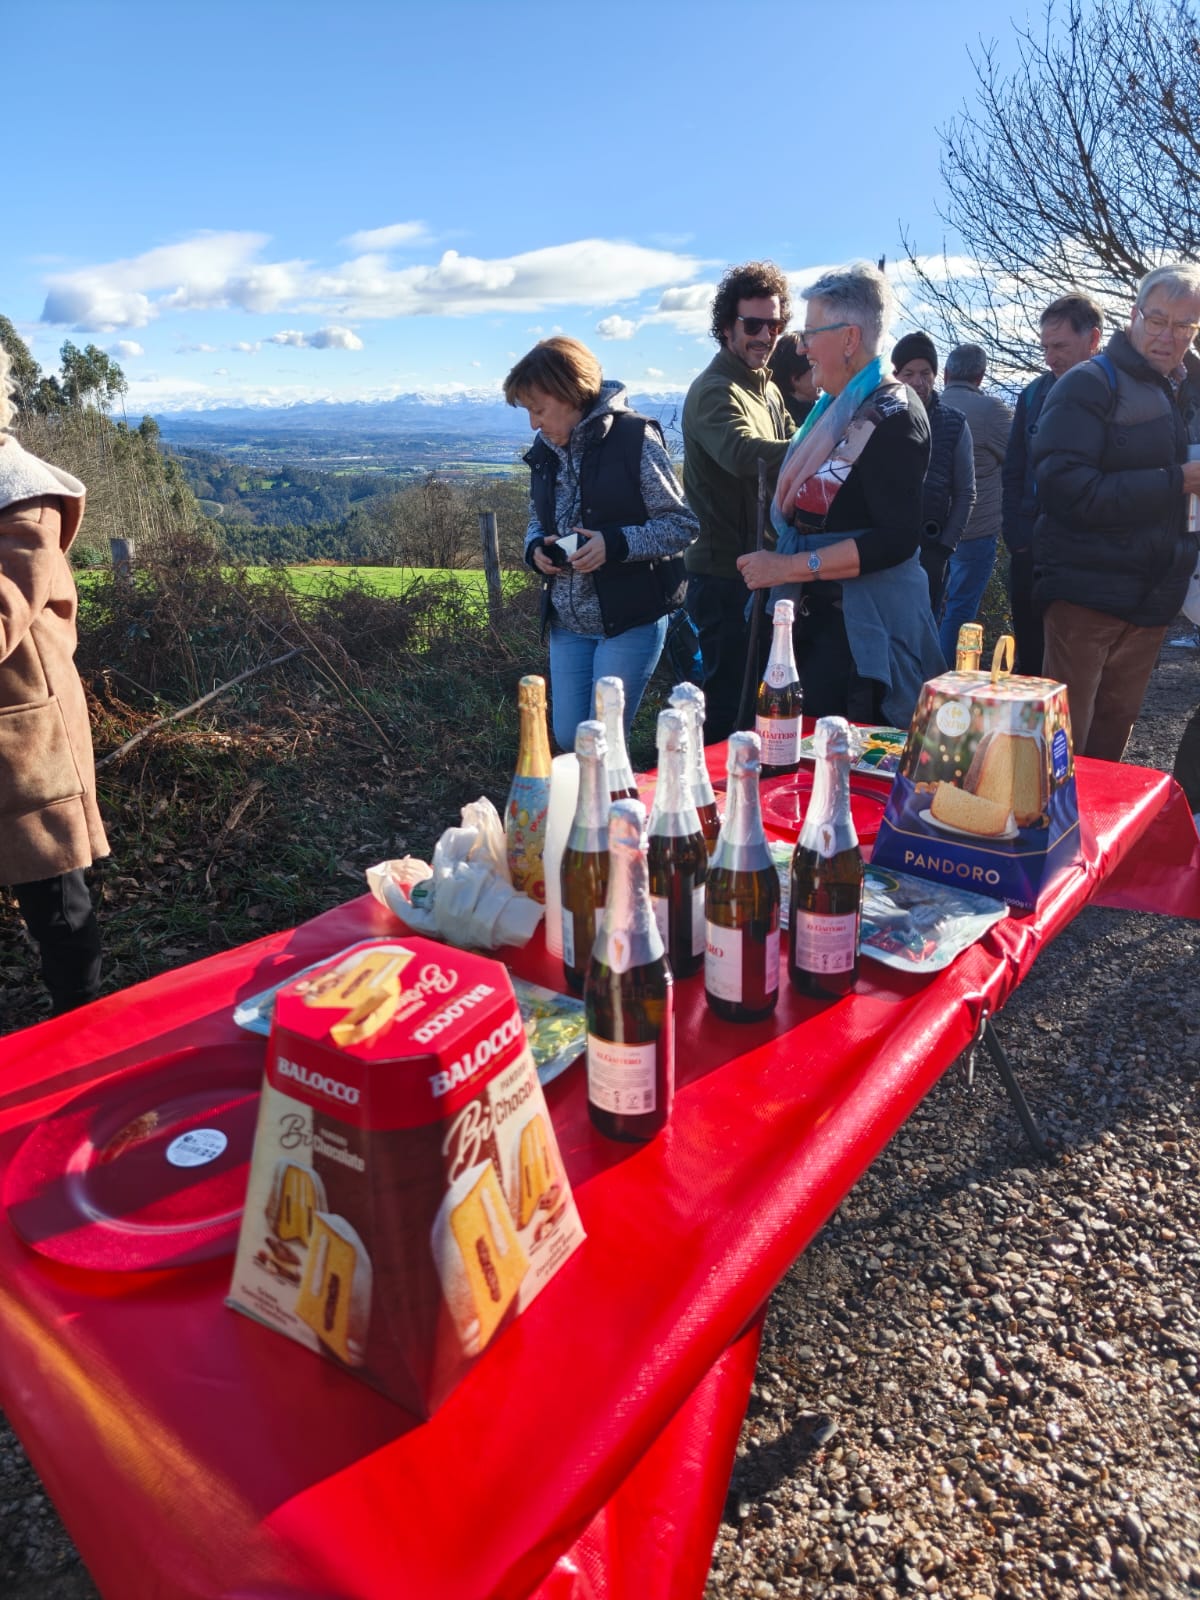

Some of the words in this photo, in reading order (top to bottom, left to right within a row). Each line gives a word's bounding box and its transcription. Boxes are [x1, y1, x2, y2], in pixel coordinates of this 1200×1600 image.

[904, 850, 1000, 885] PANDORO
[412, 983, 496, 1045] BALOCCO
[277, 1055, 361, 1105] BALOCCO
[428, 1009, 523, 1098] BALOCCO
